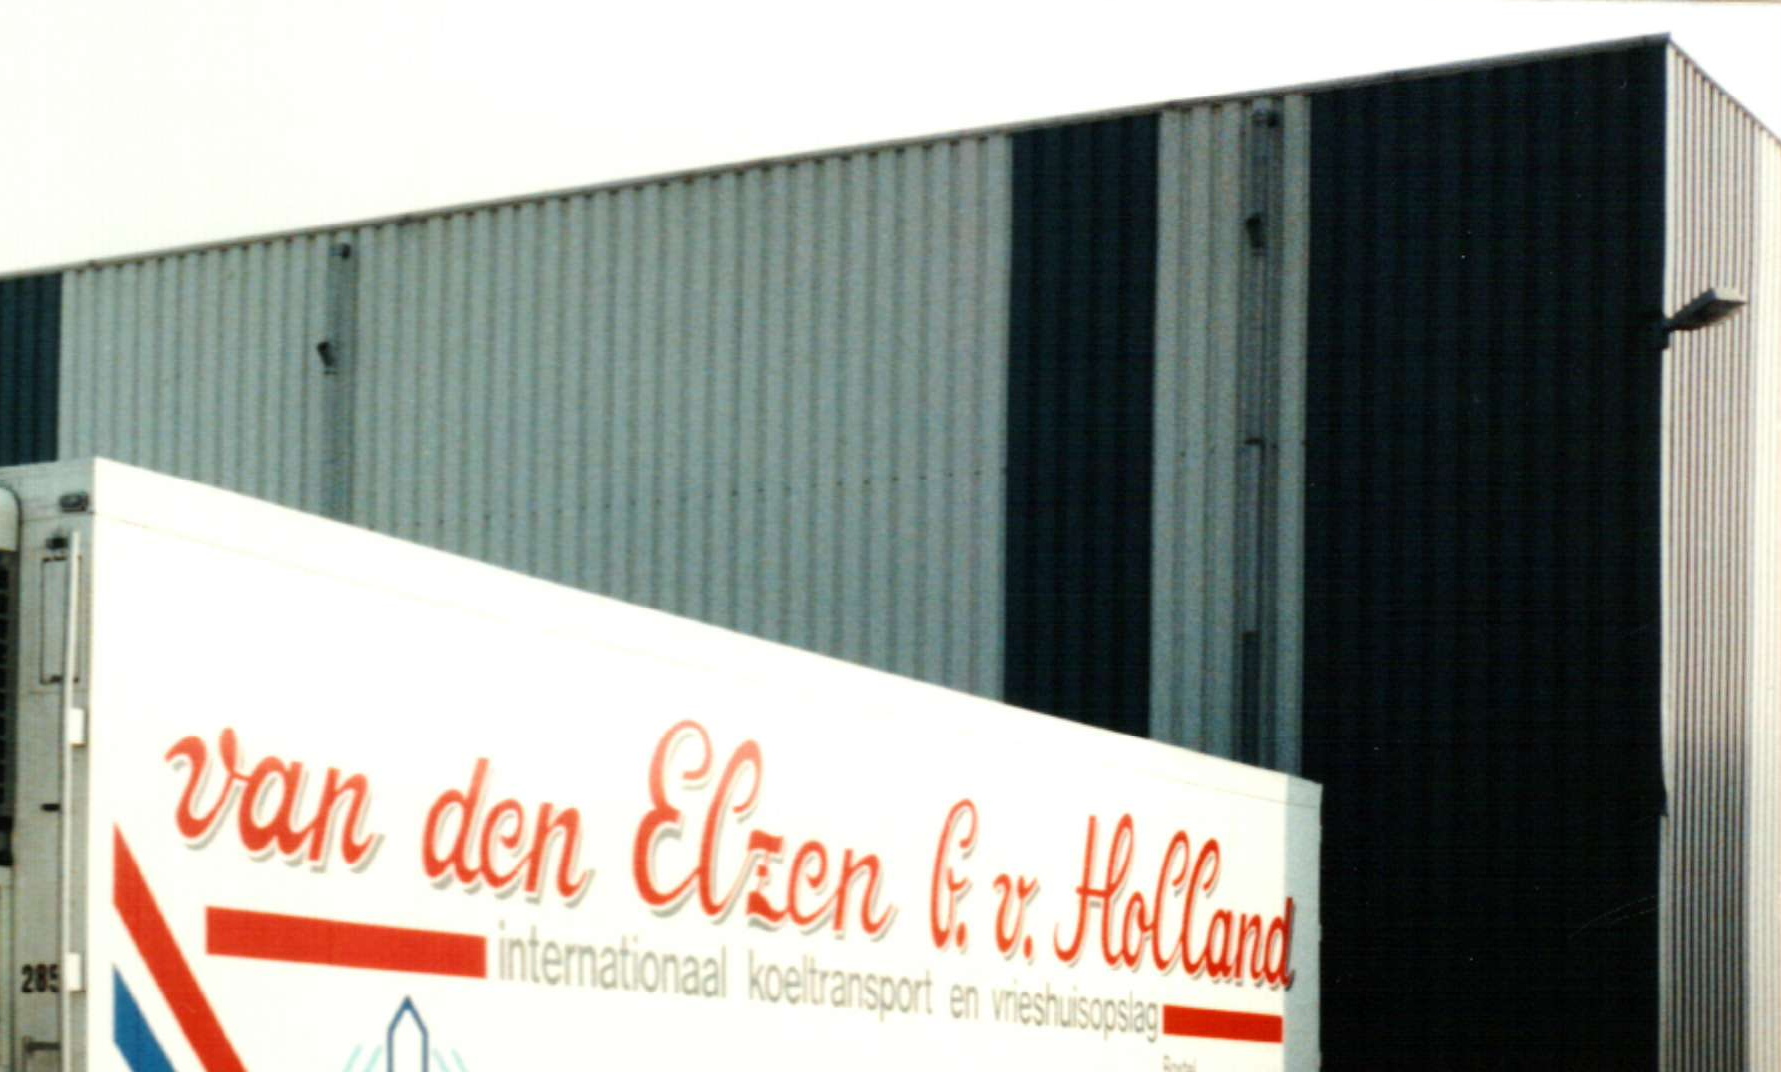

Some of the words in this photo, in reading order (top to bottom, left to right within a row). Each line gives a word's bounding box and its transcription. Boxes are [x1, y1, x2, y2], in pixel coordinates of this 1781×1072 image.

[164, 728, 384, 873] van
[422, 757, 595, 908] den
[632, 720, 898, 936] Elzen
[1054, 814, 1296, 991] Holland
[498, 921, 726, 999] internationaal
[748, 949, 933, 1023] koeltransport
[950, 983, 979, 1019] en
[992, 986, 1159, 1042] vrieshuisopslag
